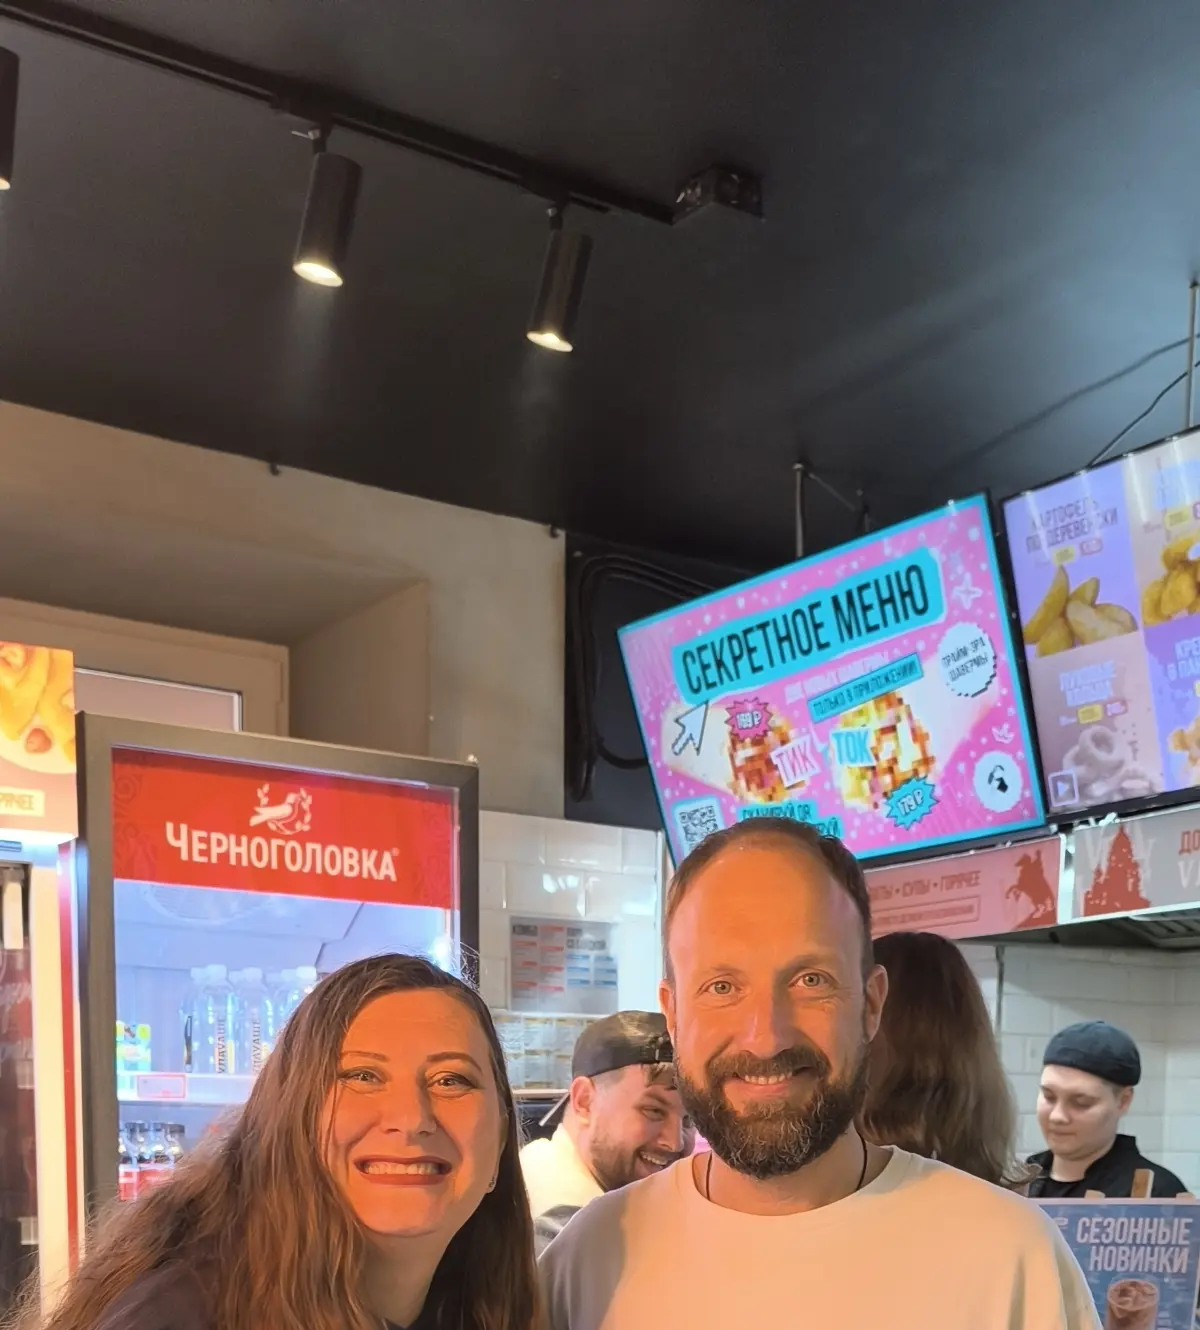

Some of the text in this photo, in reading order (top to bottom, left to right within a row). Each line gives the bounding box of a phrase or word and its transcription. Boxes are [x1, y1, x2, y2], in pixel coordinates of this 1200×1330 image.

[682, 601, 830, 695] СЕКРЕТНОЕ
[830, 564, 929, 643] МЕНЮ
[774, 730, 873, 781] ТИК ТОК
[1076, 1217, 1193, 1245] СЕЗОННЫЕ
[1089, 1246, 1190, 1273] НОВИНКИ
